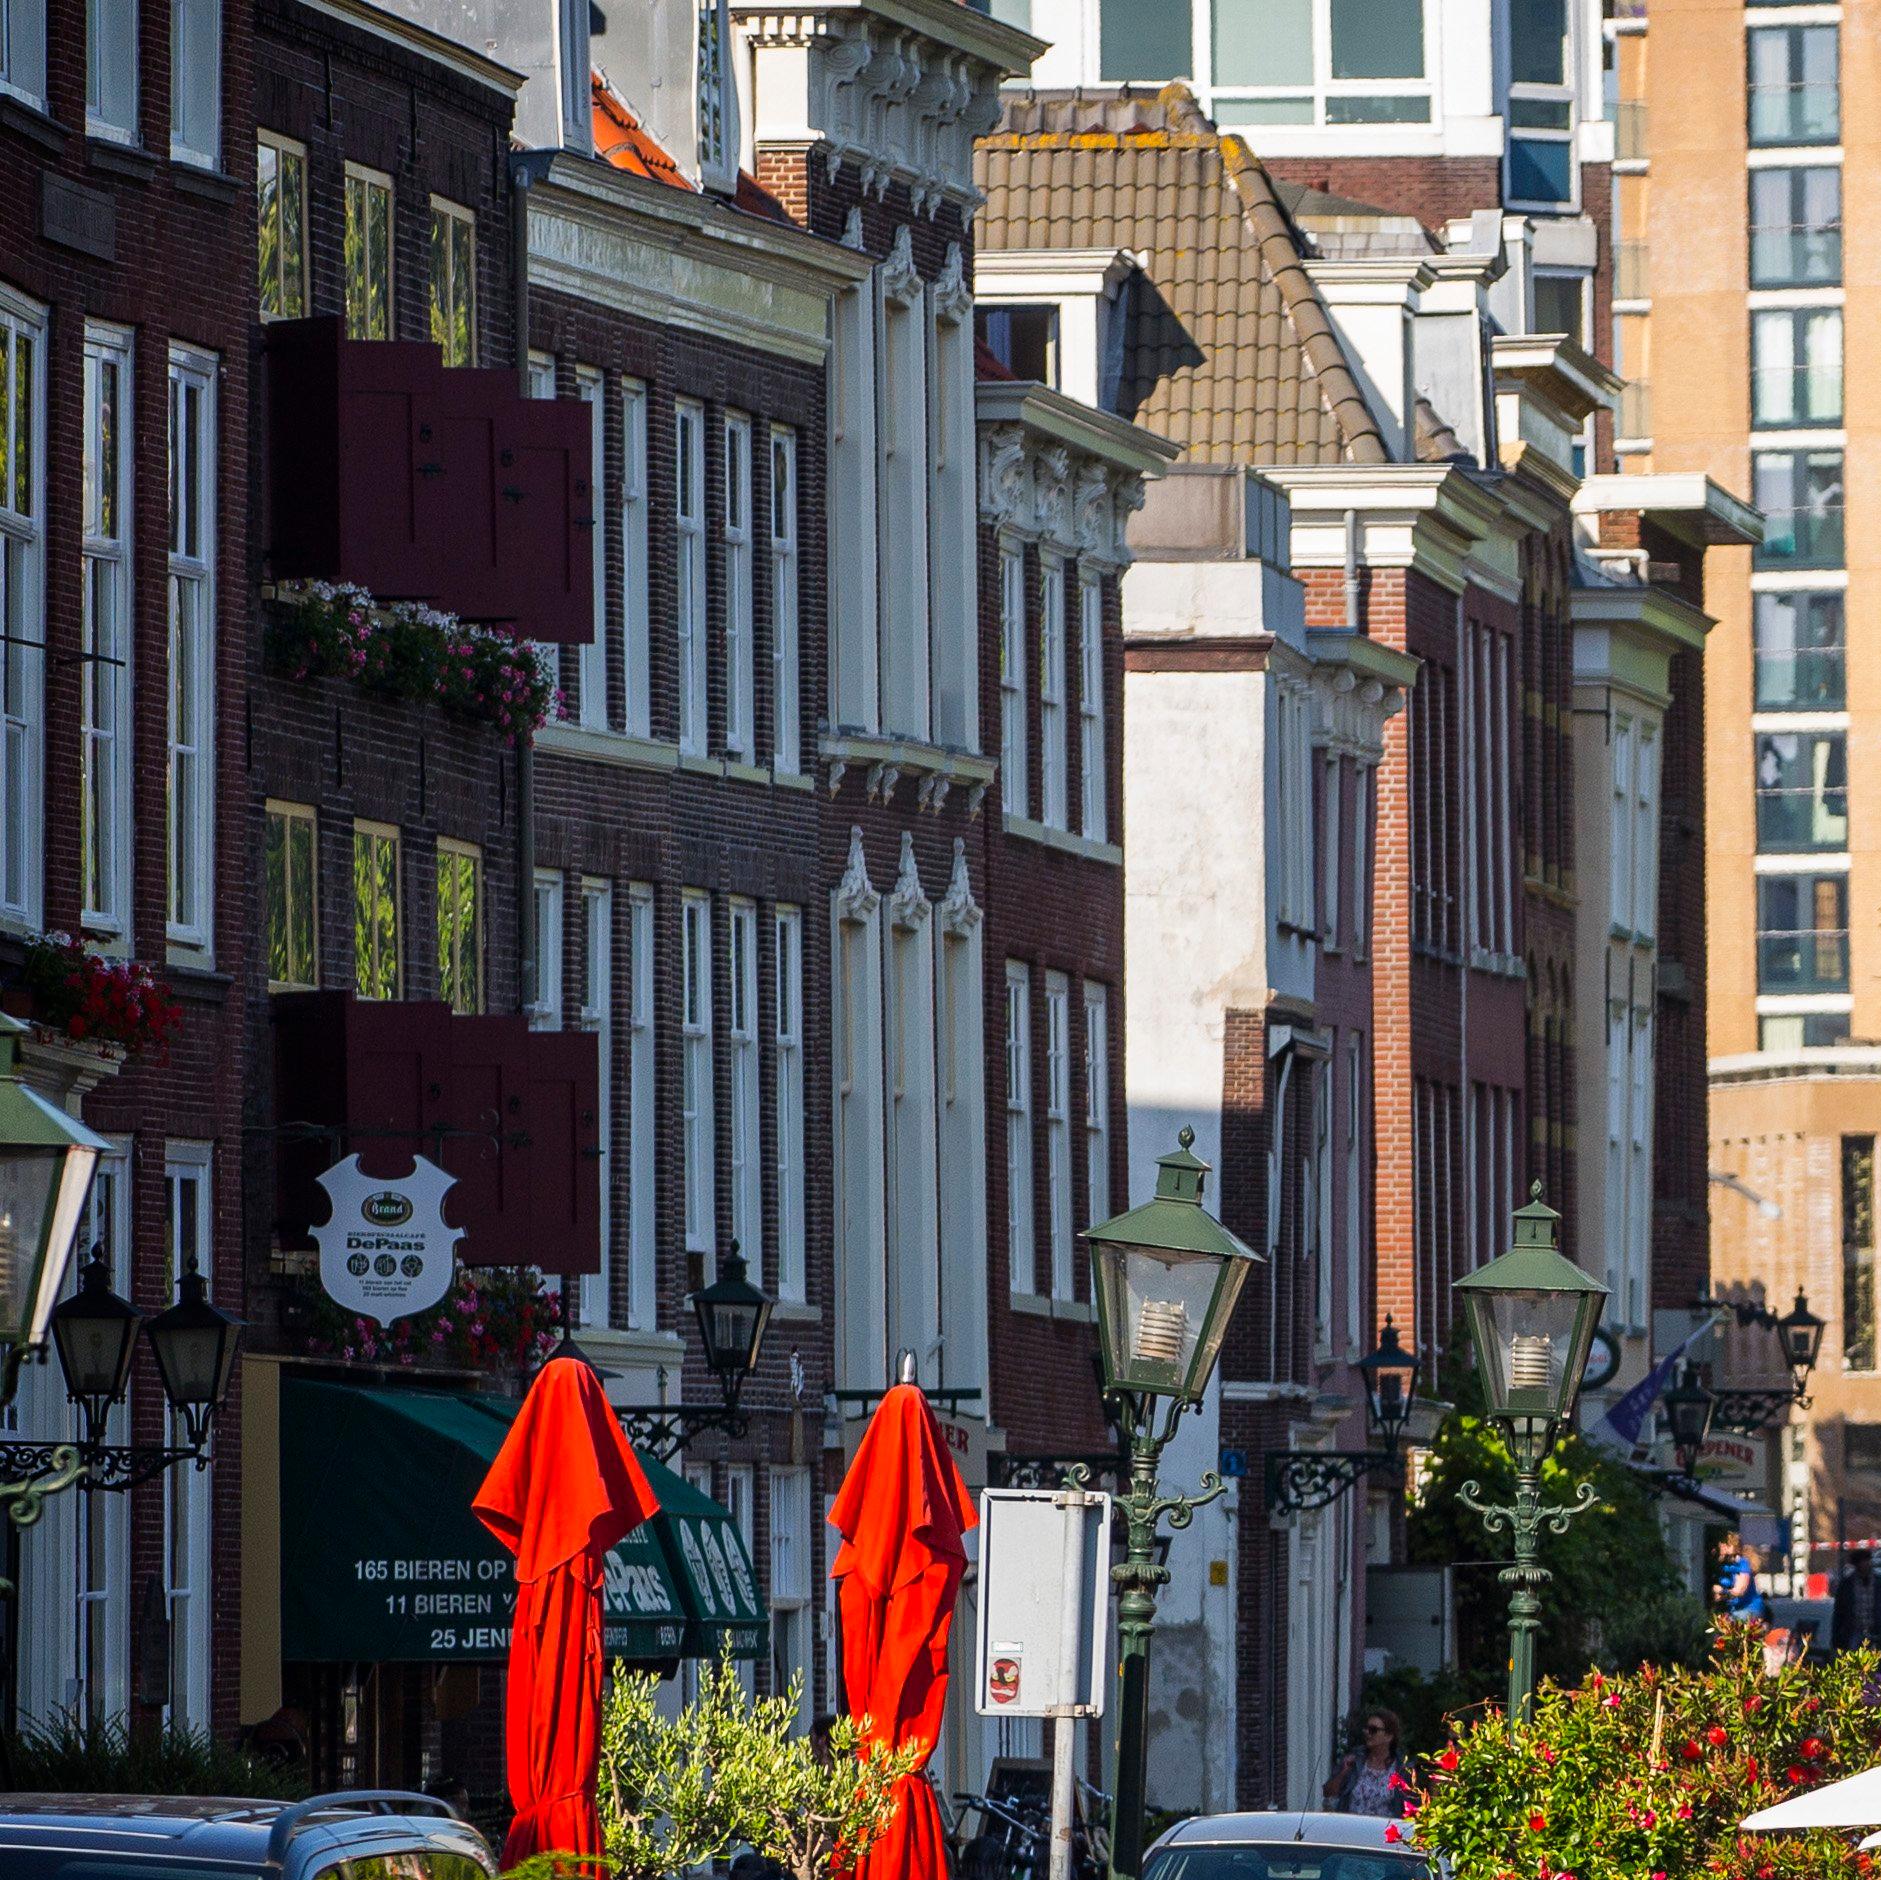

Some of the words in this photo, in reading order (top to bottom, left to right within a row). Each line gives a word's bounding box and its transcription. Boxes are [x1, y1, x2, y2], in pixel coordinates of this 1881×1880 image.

[372, 1202, 403, 1214] Brand
[354, 1560, 387, 1579] 165
[394, 1560, 470, 1579] BIEREN
[477, 1560, 506, 1579] OP
[386, 1595, 405, 1613] 11
[415, 1594, 491, 1613] BIEREN
[431, 1629, 456, 1648] 25
[461, 1628, 513, 1648] JEN
